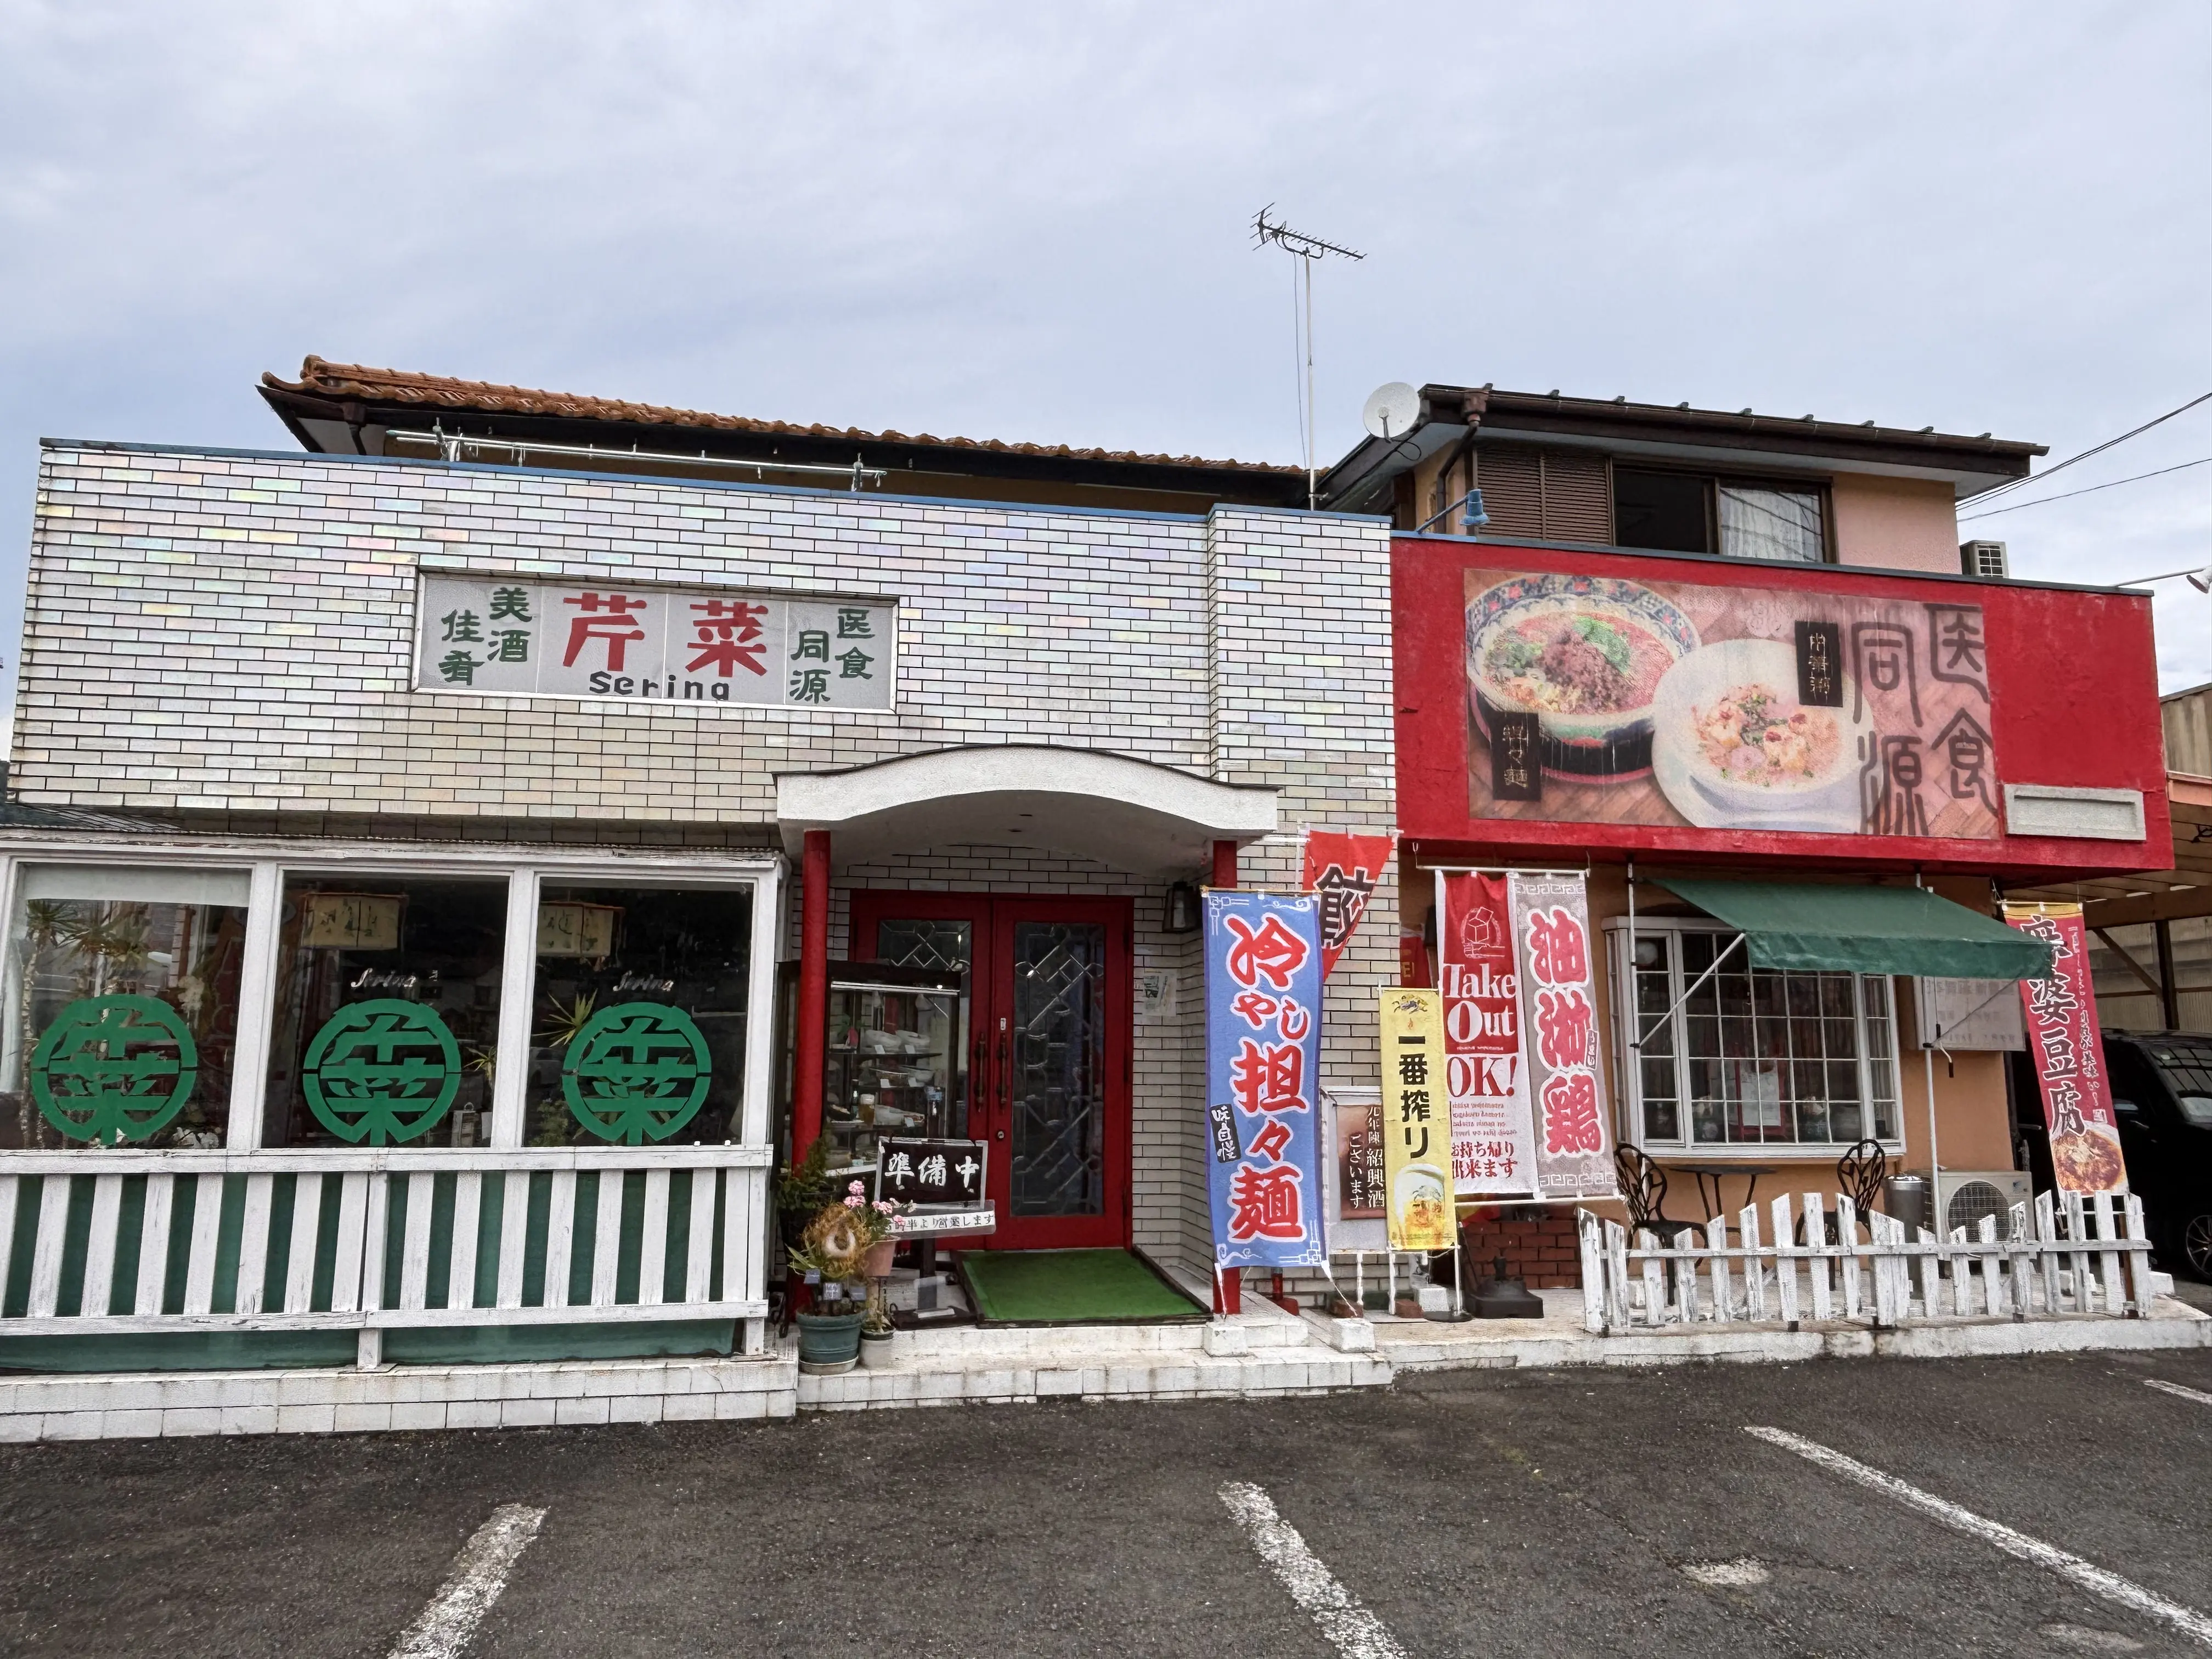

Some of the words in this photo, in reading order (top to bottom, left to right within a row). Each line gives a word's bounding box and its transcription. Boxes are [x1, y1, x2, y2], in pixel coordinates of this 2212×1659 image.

[488, 586, 533, 663] 美酒
[562, 591, 769, 678] 芹菜
[834, 607, 876, 680] 医食
[788, 630, 831, 704] 同源
[1443, 963, 1517, 999] Take
[1447, 1000, 1516, 1043] Out
[1225, 915, 1309, 1243] 冷やし担々麺
[1398, 1035, 1431, 1159] 一番搾り
[1447, 1056, 1517, 1098] OK!
[884, 1152, 980, 1189] 準備中
